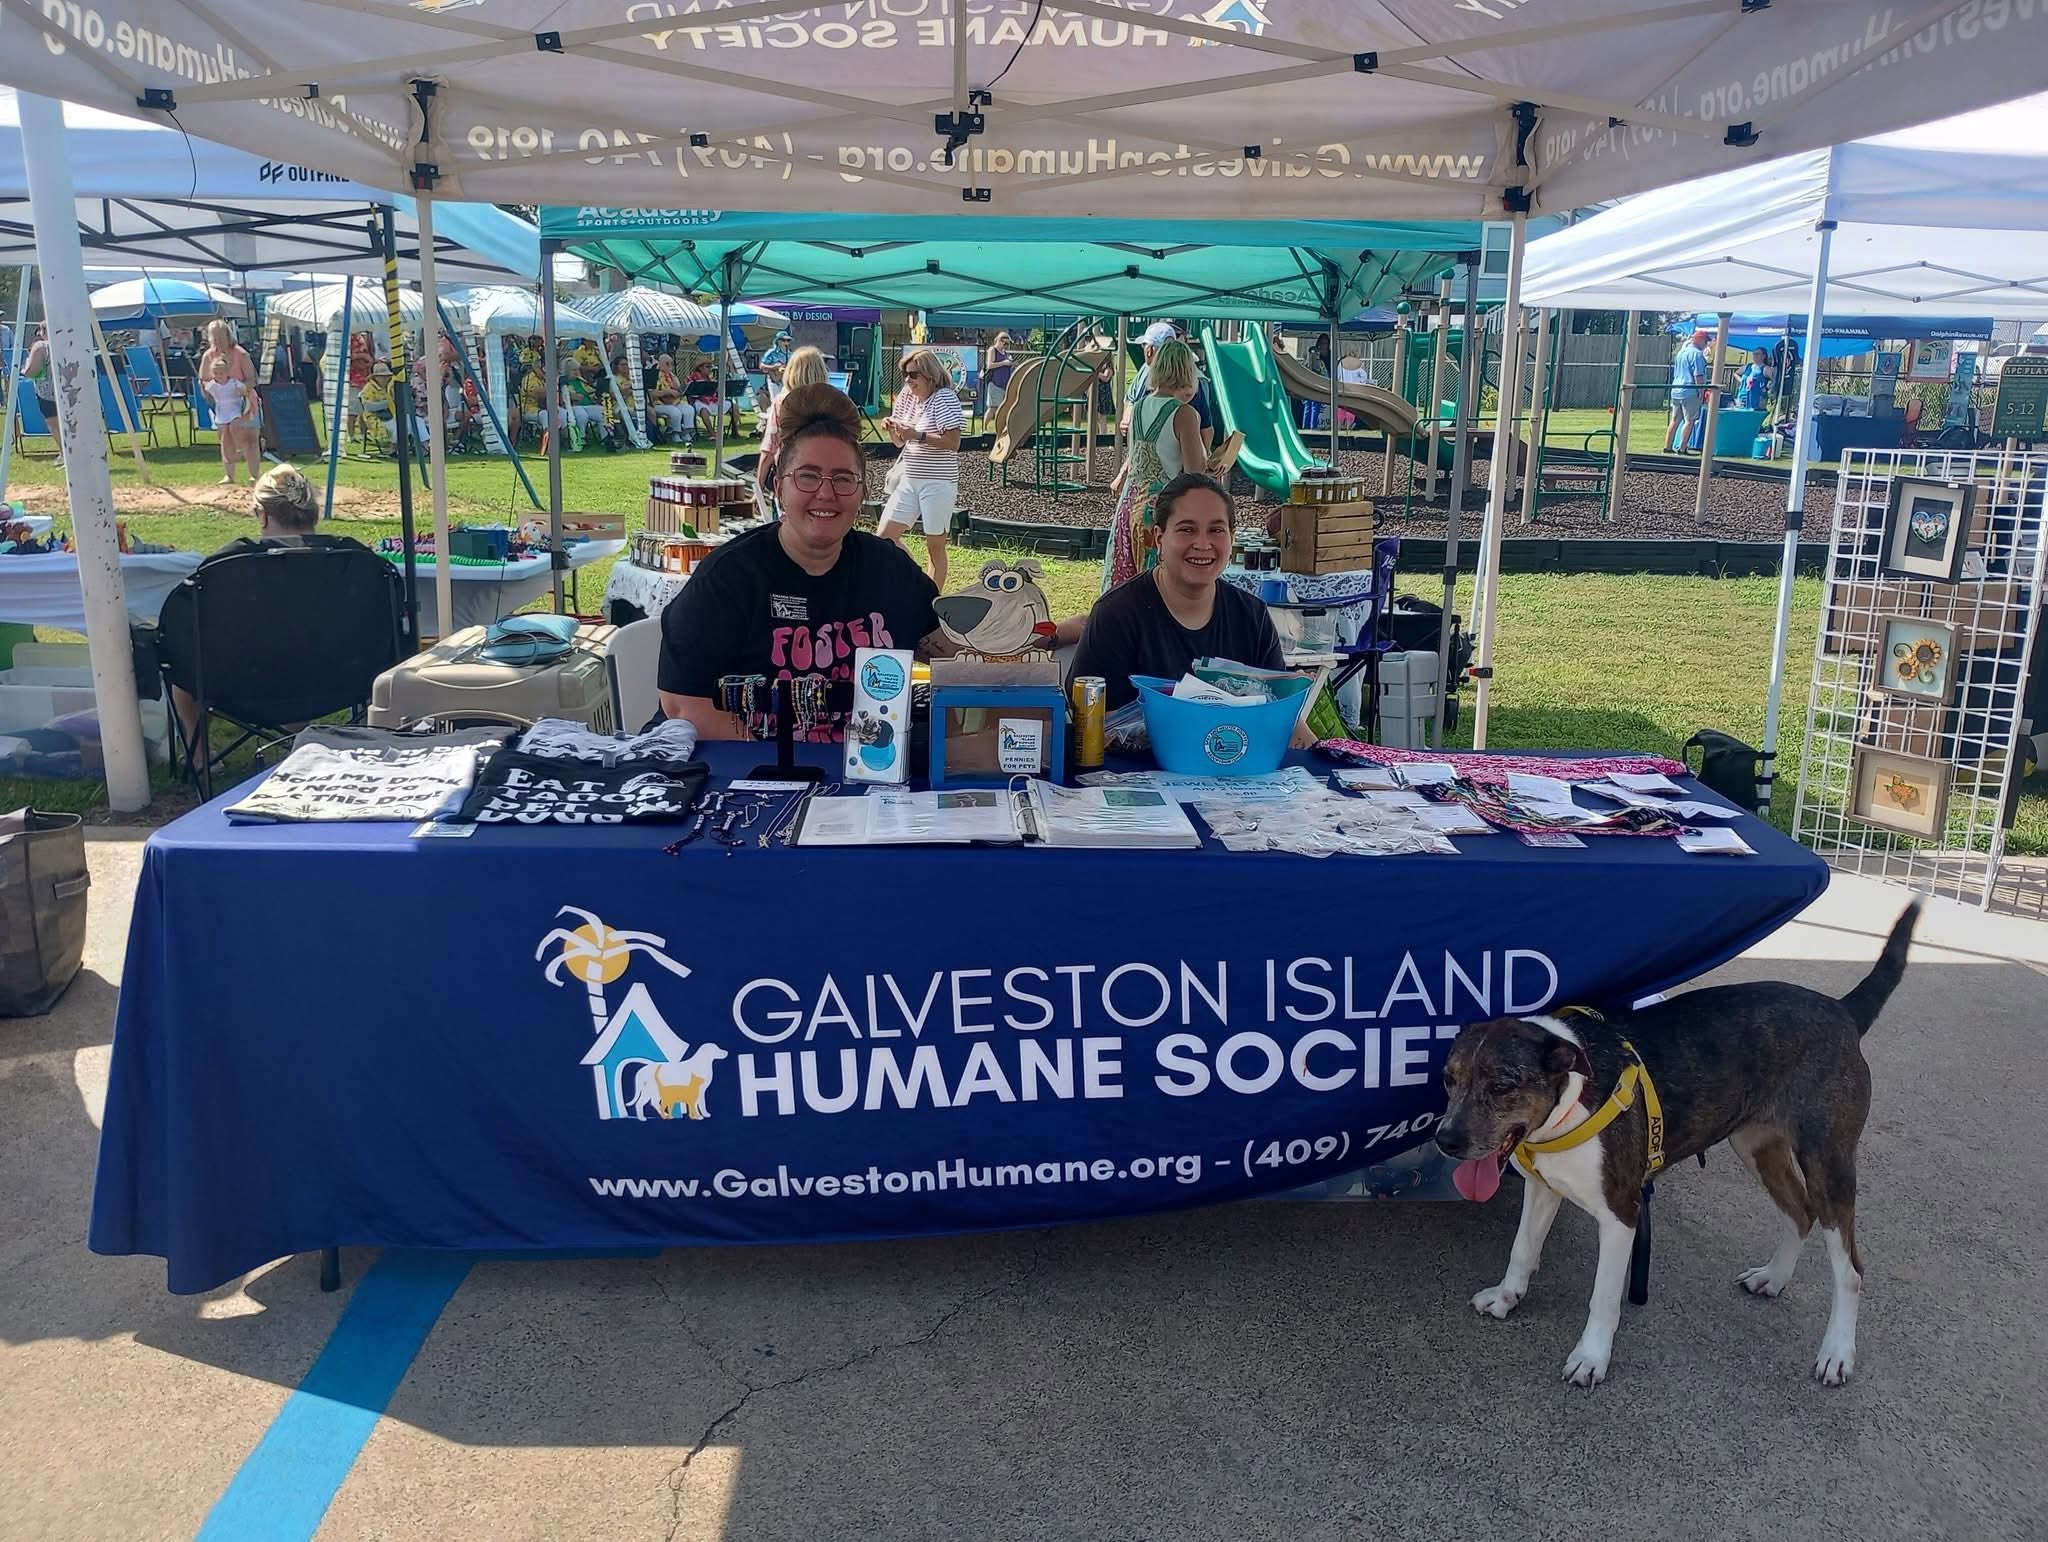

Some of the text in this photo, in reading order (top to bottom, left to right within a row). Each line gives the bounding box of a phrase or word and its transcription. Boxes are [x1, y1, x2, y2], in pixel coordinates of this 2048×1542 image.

[805, 311, 833, 321] DESIGN
[2006, 402, 2035, 415] 5-12
[771, 612, 894, 671] FOSTER
[270, 771, 337, 784] Hold
[339, 772, 384, 784] My
[503, 768, 606, 793] EAT
[311, 793, 370, 806] This
[483, 796, 589, 813] PET
[732, 948, 1558, 1043] GALVESTON ISLAND
[737, 1025, 1460, 1117] HUMANE SOCIE
[588, 1154, 1202, 1198] www.GalvestonHumane.org
[1243, 1130, 1350, 1177] (409)
[1364, 1111, 1448, 1150] 740-
